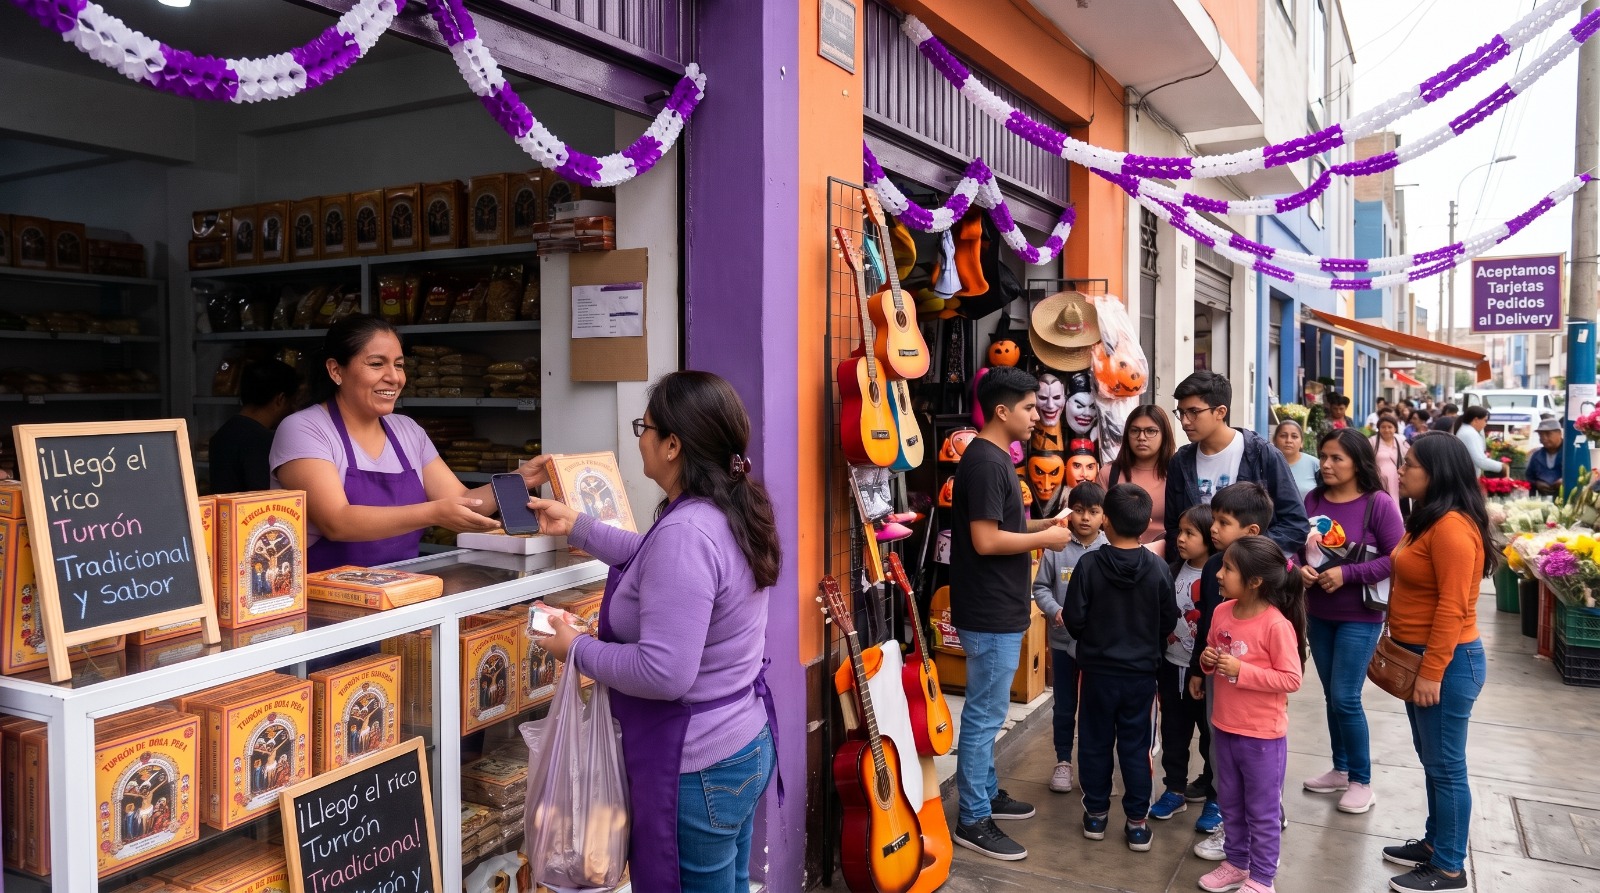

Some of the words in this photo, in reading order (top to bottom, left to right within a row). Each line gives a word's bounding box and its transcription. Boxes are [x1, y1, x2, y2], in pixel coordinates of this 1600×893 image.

[1476, 265, 1556, 280] Aceptamos
[1487, 281, 1544, 295] Tarjetas
[1487, 297, 1545, 310] Pedidos
[1479, 313, 1491, 326] al
[1495, 313, 1553, 327] Delivery
[126, 444, 147, 471] el
[51, 489, 99, 512] rico
[53, 512, 142, 544] Turrón
[56, 537, 190, 582] Tradicional
[73, 589, 88, 620] y
[100, 575, 174, 604] Sabor
[136, 742, 146, 752] DE
[365, 773, 380, 802] el
[387, 770, 417, 794] rico
[302, 815, 380, 863] Turrón
